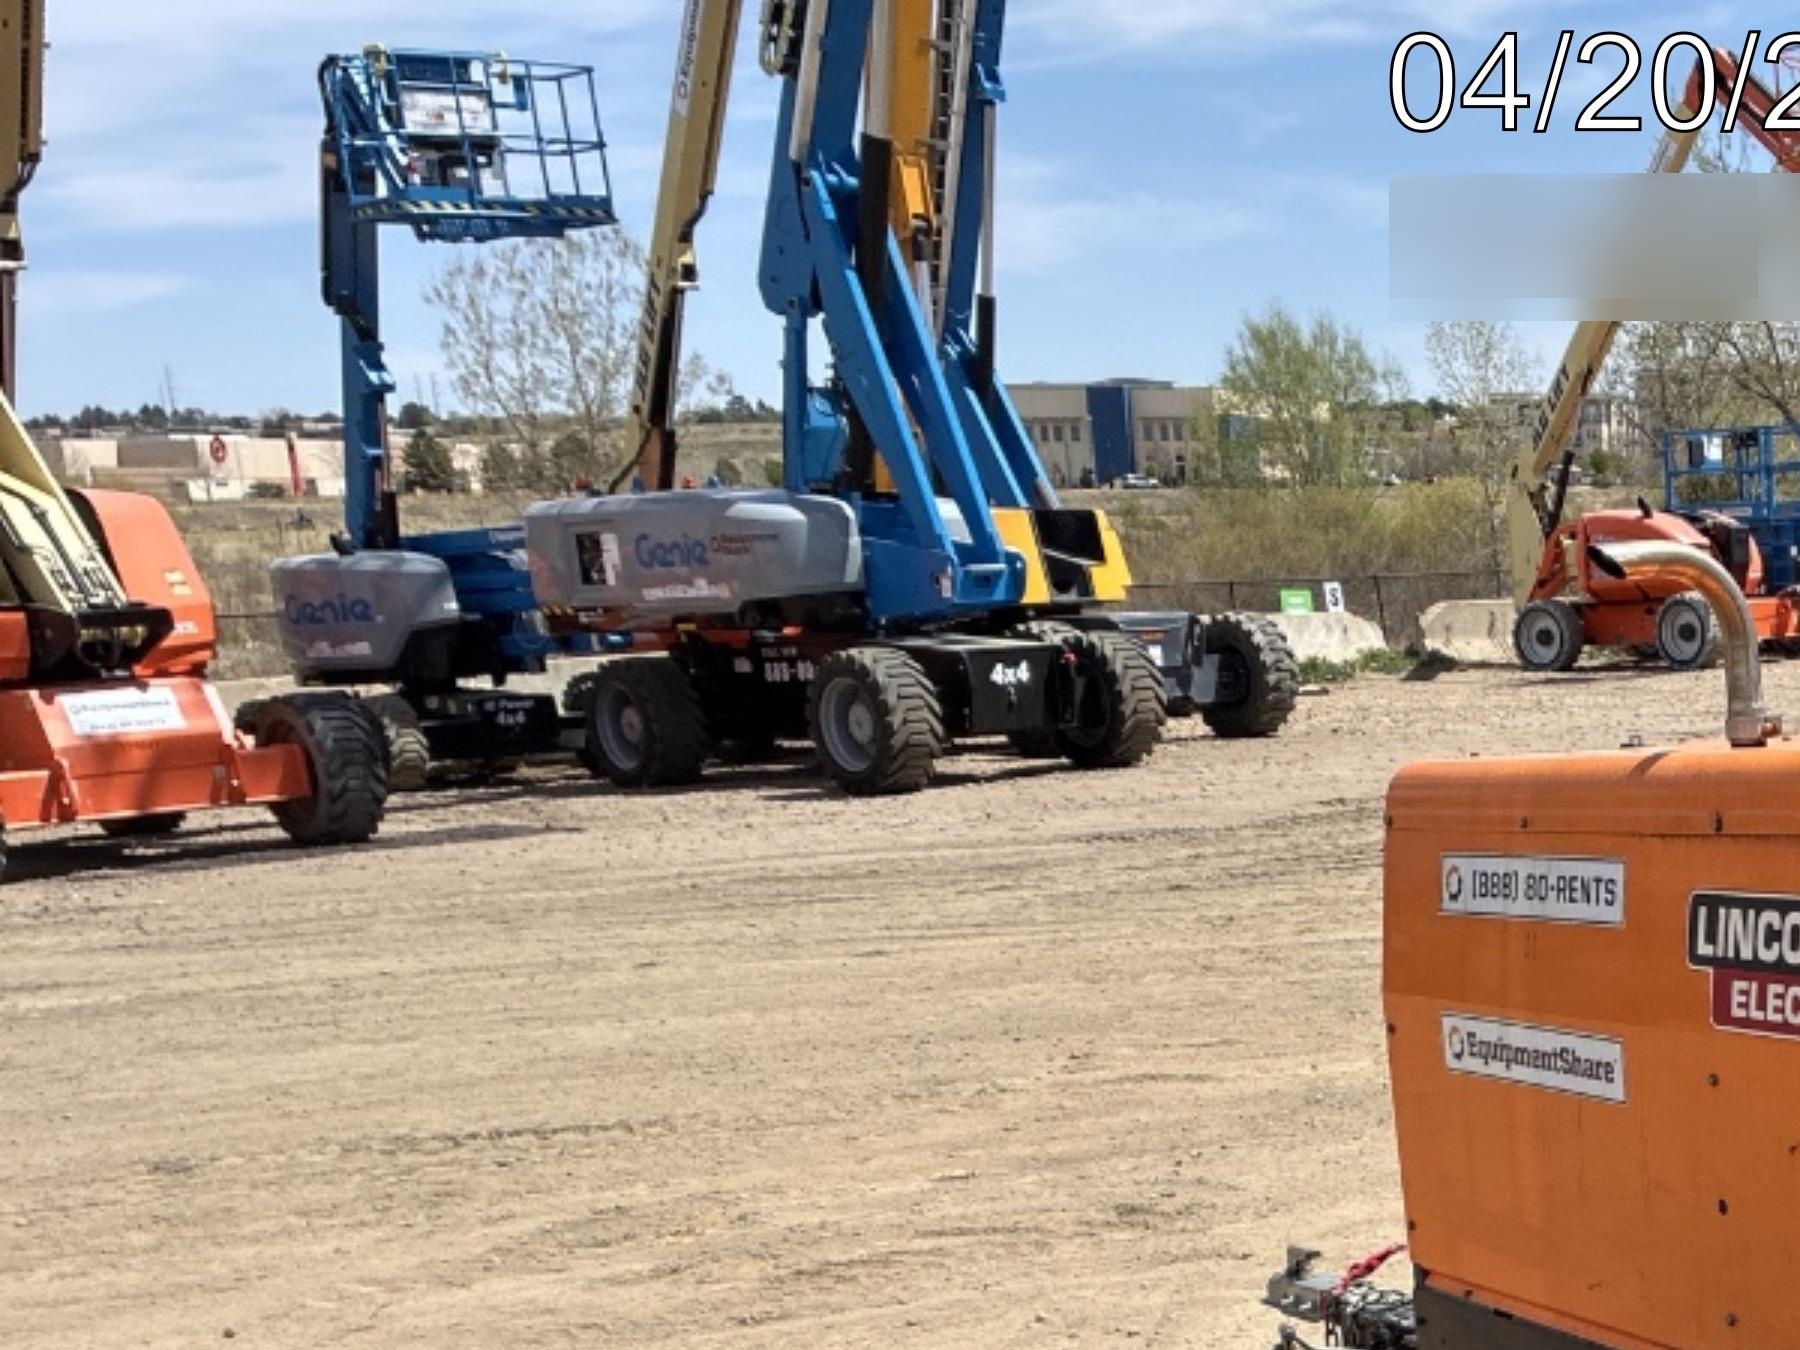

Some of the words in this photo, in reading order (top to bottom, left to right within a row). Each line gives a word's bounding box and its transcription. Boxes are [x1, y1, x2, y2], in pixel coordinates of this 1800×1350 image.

[635, 533, 709, 568] Genie
[285, 594, 376, 625] Genie
[990, 660, 1030, 686] 4x4
[1471, 869, 1519, 903] (888)
[1524, 872, 1618, 907] 80-RENTS
[1466, 1031, 1618, 1084] EquipmentShare
